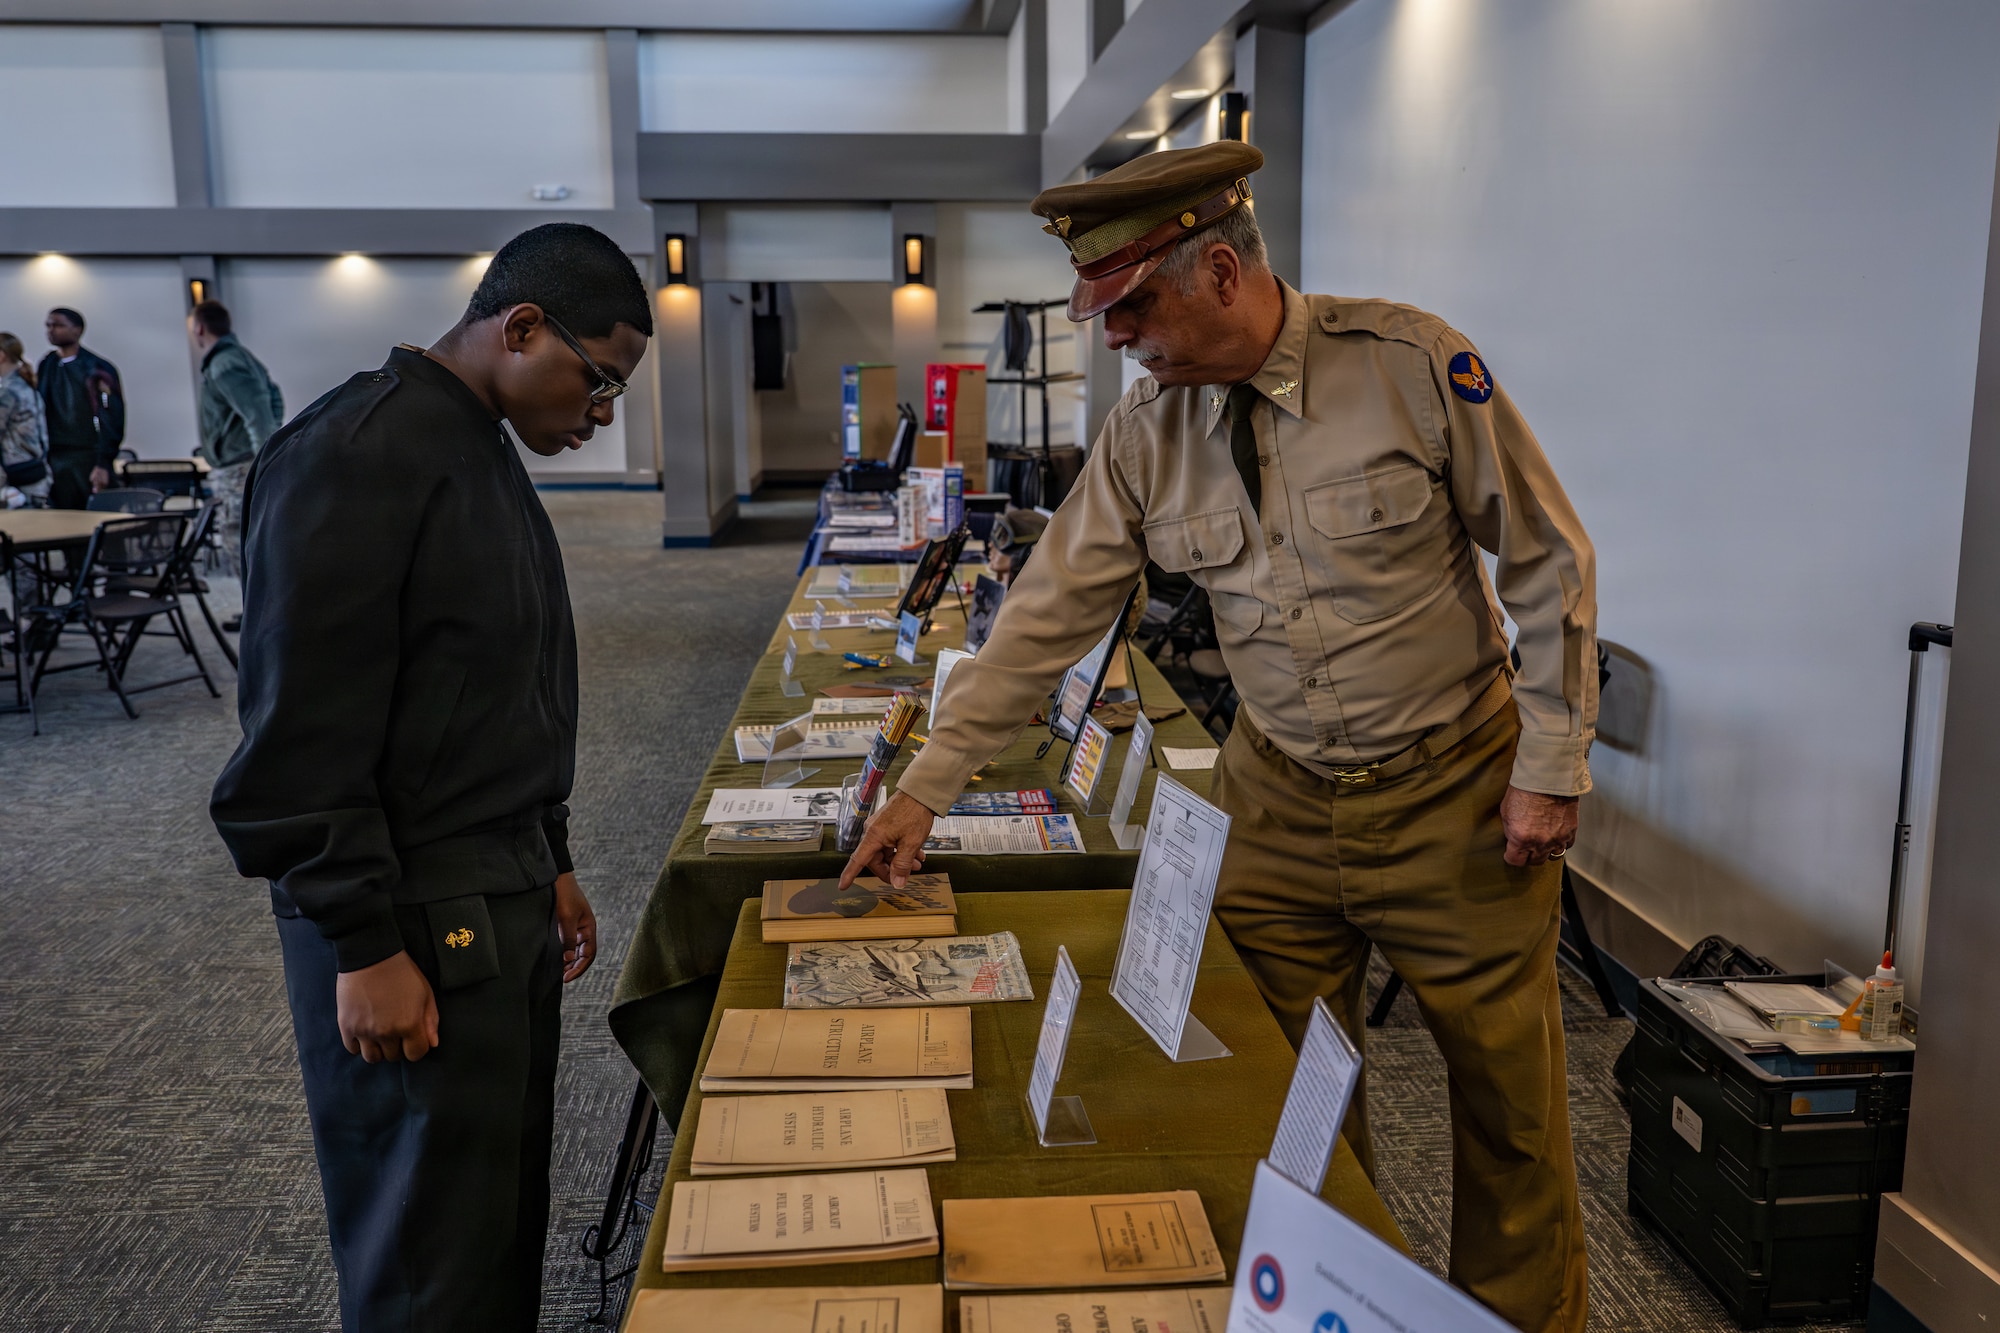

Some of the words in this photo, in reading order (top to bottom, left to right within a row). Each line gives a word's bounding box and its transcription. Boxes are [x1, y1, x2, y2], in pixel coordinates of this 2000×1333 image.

[823, 1018, 845, 1069] STRUCTURES
[857, 1024, 875, 1064] AIRPLANE
[783, 1112, 797, 1146] SYSTEMS
[811, 1106, 825, 1151] HYDRAULIC
[839, 1108, 852, 1146] AIRPLANE
[748, 1203, 760, 1233] SYSTEMS
[776, 1192, 787, 1209] FUEL
[828, 1195, 841, 1230] AIRCRAFT
[776, 1211, 787, 1226] AND
